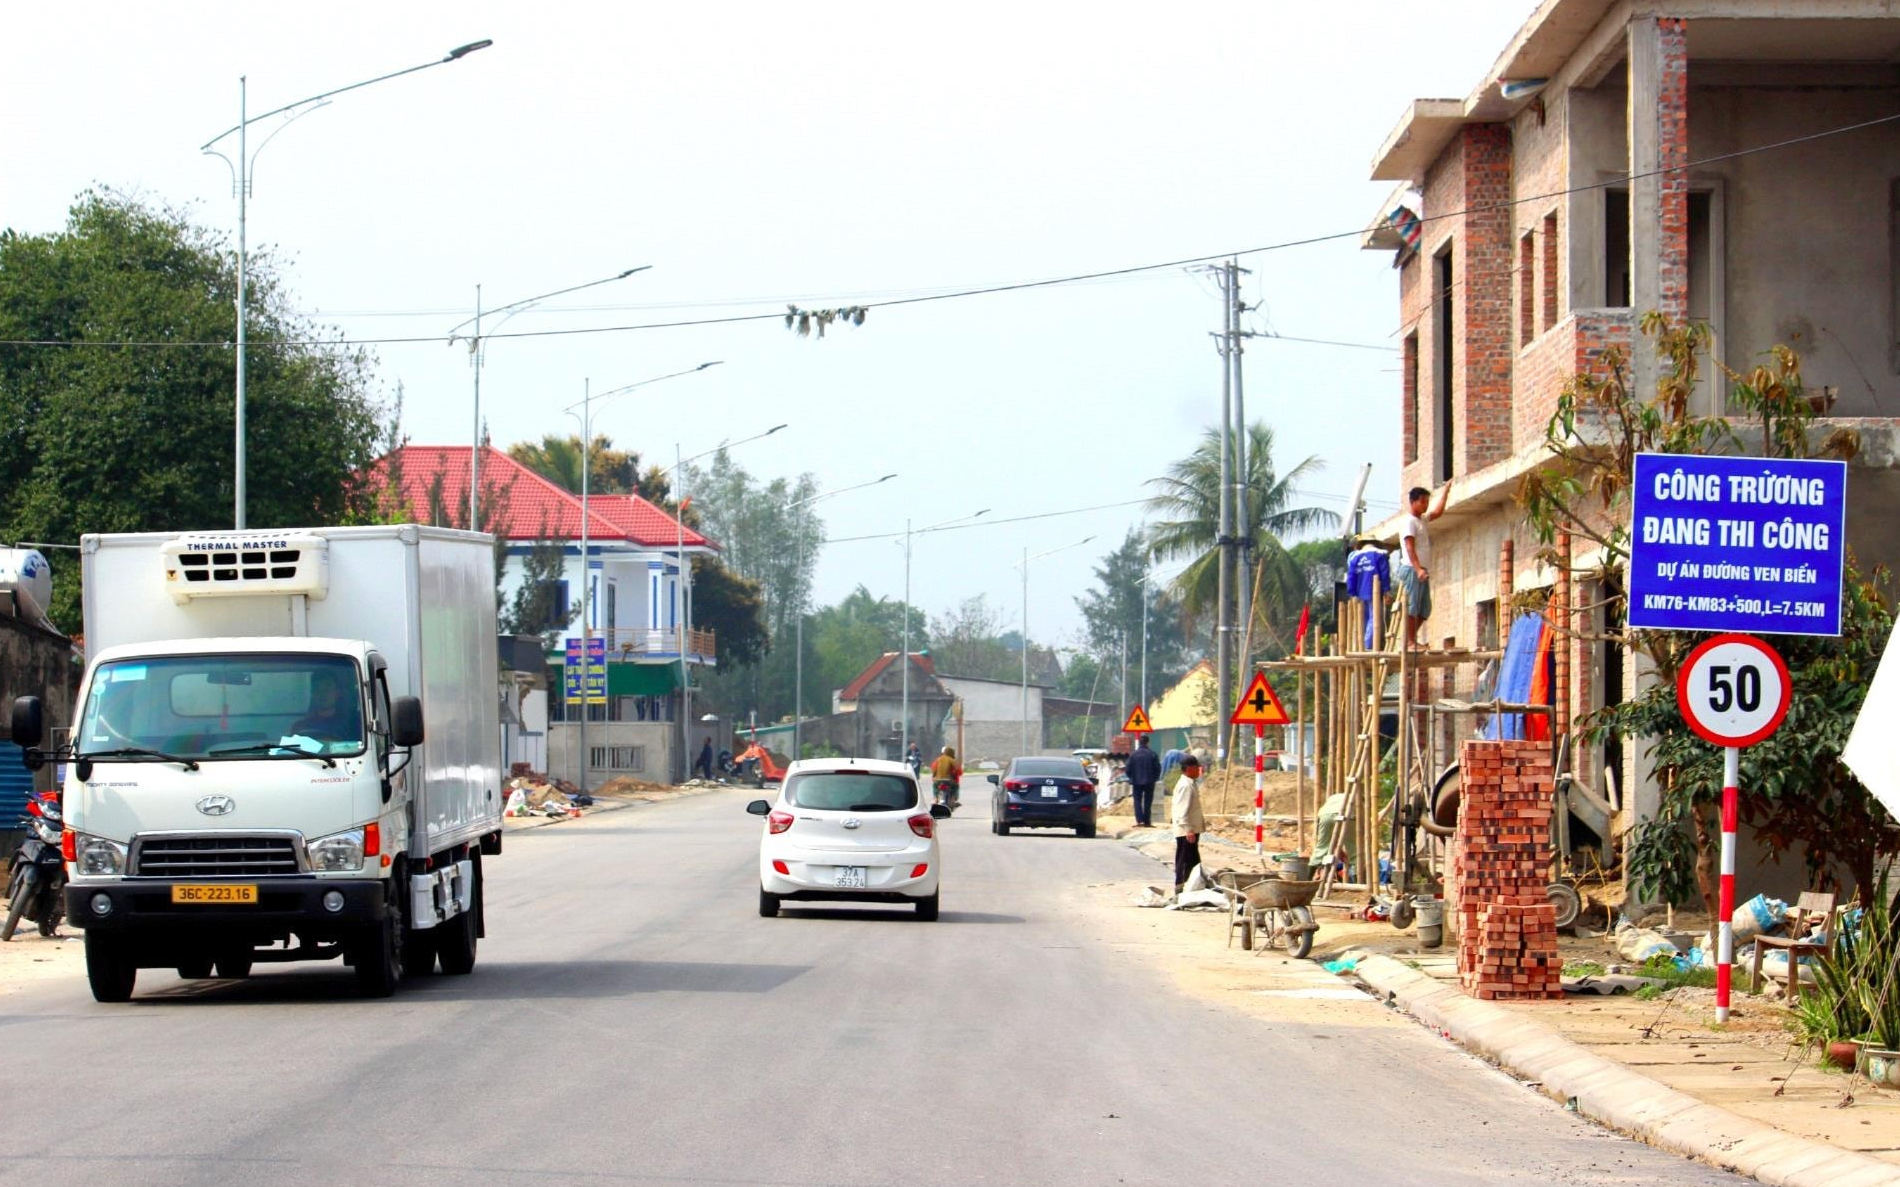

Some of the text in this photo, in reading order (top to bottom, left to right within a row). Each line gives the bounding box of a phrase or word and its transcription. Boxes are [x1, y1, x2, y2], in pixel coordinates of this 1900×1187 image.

[1654, 468, 1721, 502] CÔNG
[187, 540, 287, 551] THERMAL MASTER
[1643, 517, 1829, 551] ĐANG THI CÔNG
[1657, 559, 1817, 584] DỰ ÁN ĐƯỜNG VEN BIỂN
[1709, 664, 1761, 713] 50
[842, 868, 859, 878] 37A
[179, 888, 251, 900] 36C-223.16
